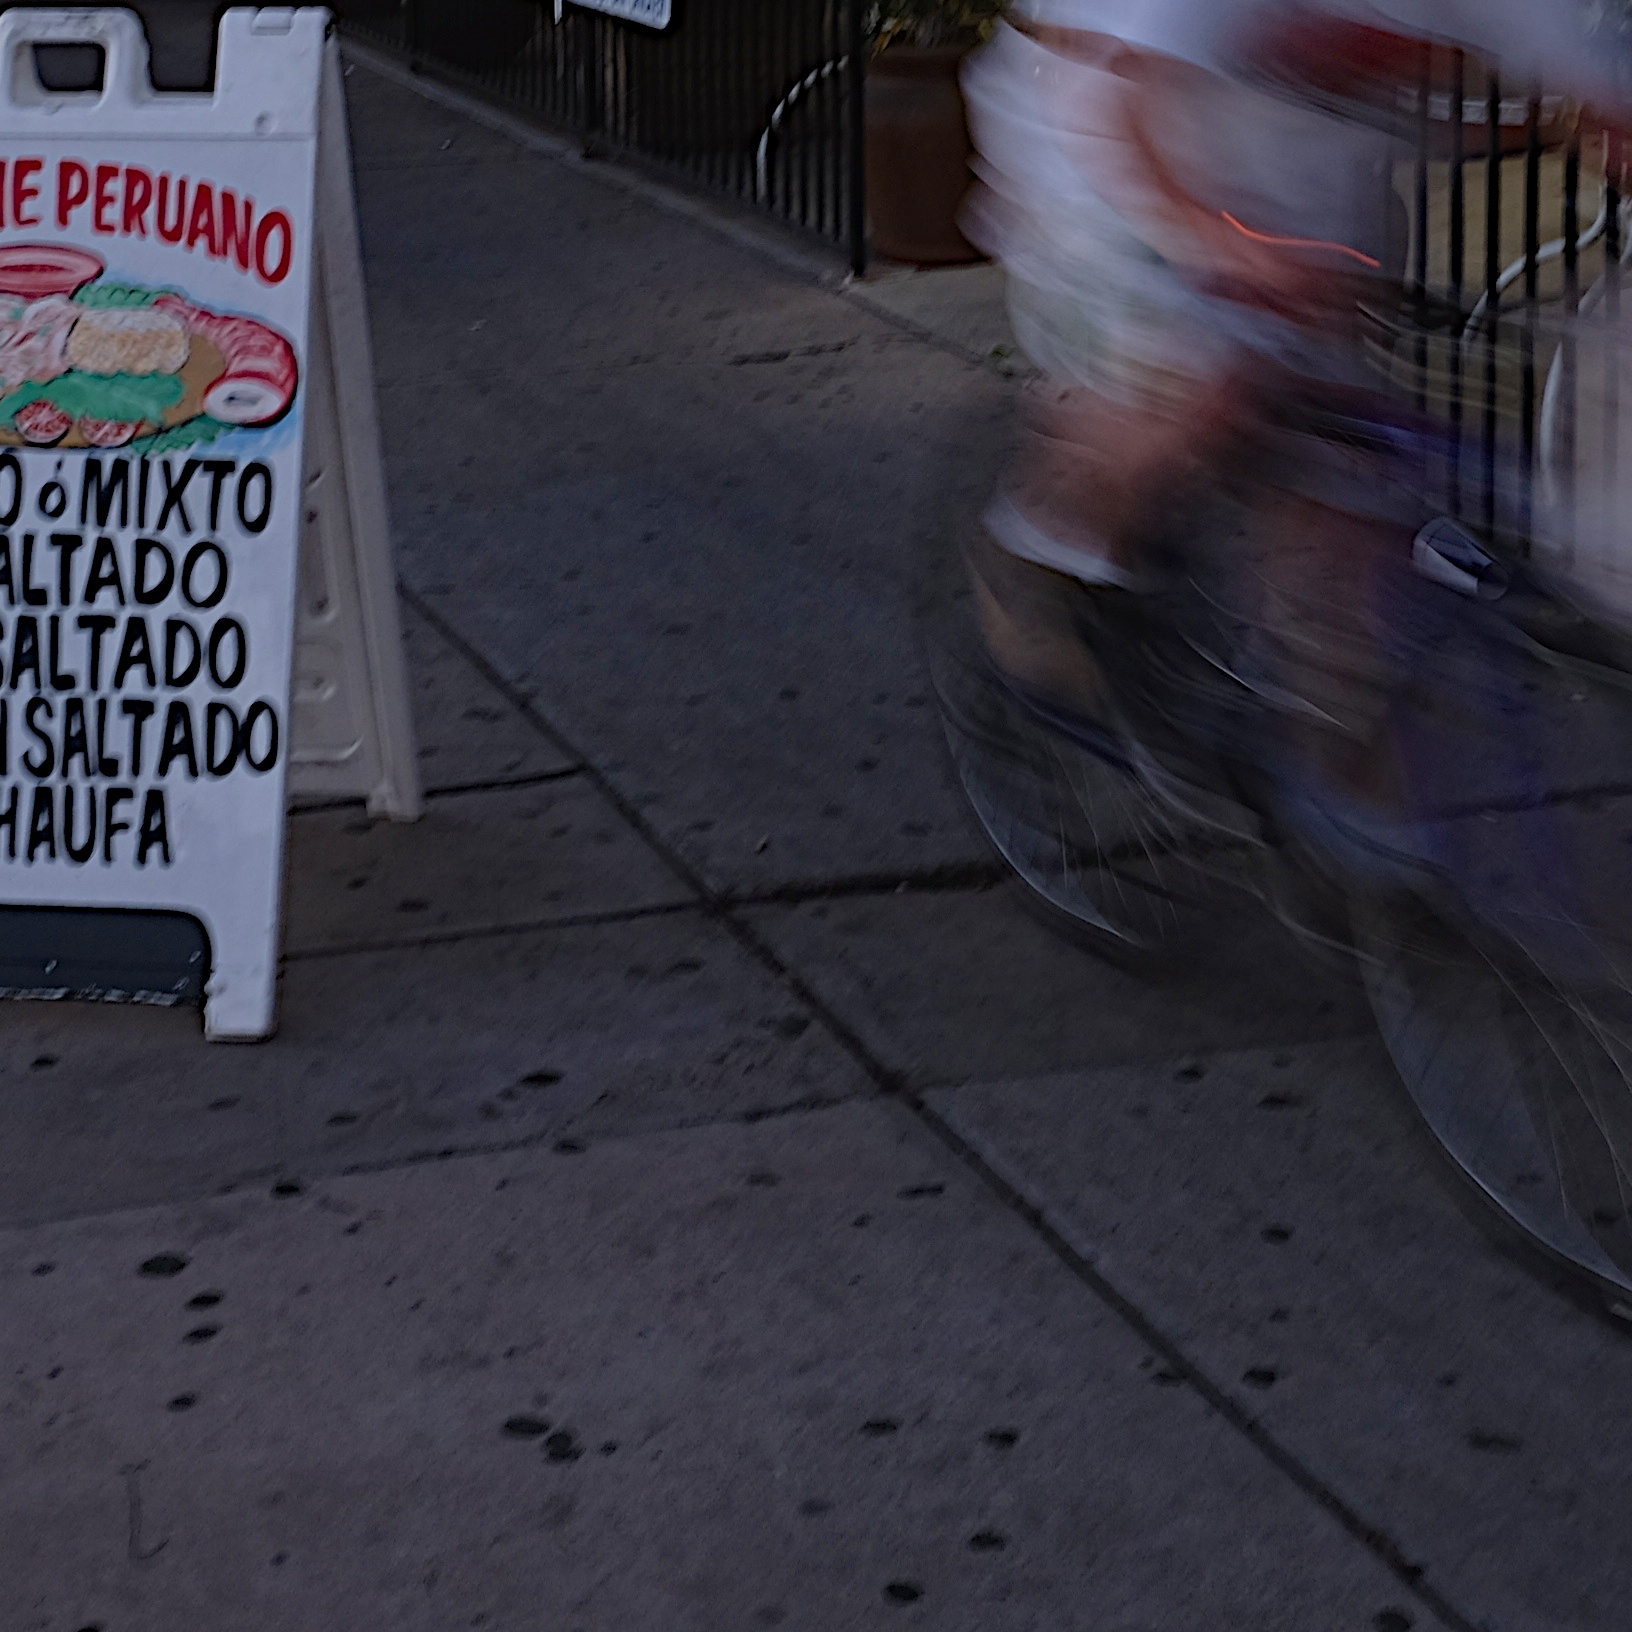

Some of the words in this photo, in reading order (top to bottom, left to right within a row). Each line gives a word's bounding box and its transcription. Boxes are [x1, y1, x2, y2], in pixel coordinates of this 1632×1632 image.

[56, 161, 293, 285] PERUANO
[80, 457, 273, 534] MIXTO
[22, 695, 280, 778] SALTADO
